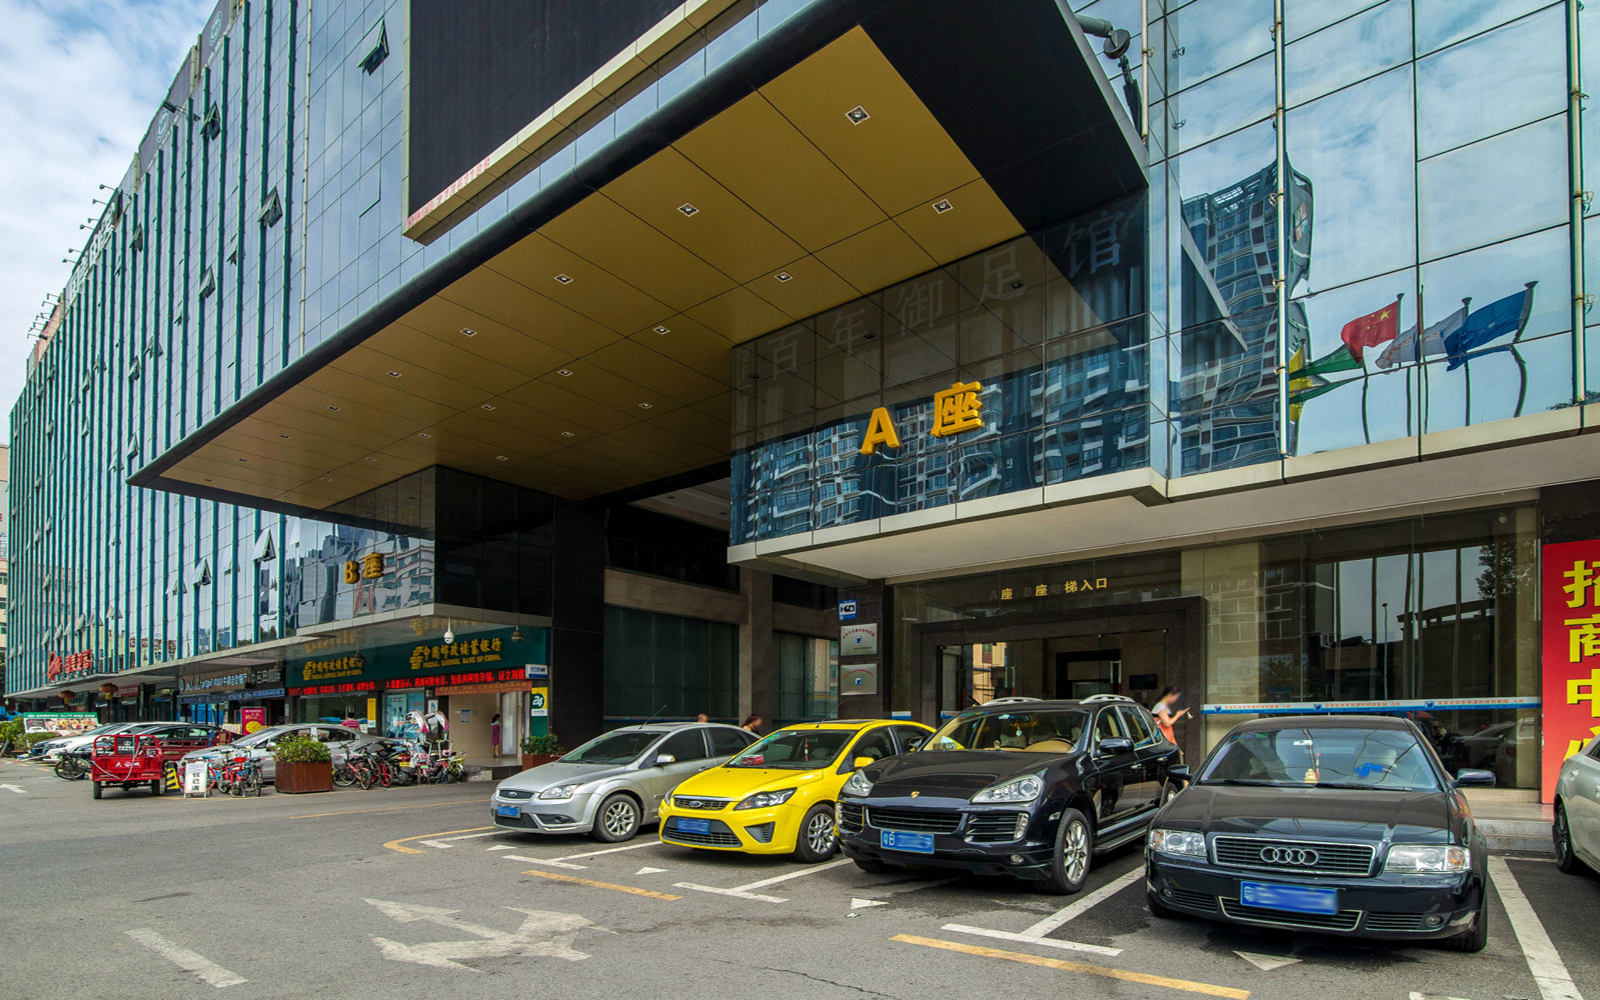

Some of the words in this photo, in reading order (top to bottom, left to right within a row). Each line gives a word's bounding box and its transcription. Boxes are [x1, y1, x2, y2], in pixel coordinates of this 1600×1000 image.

[767, 209, 1126, 380] 百年御足馆
[860, 381, 985, 456] A座
[344, 552, 384, 585] B座
[423, 637, 503, 662] 中国邮政储蓄银行
[532, 696, 543, 708] 24
